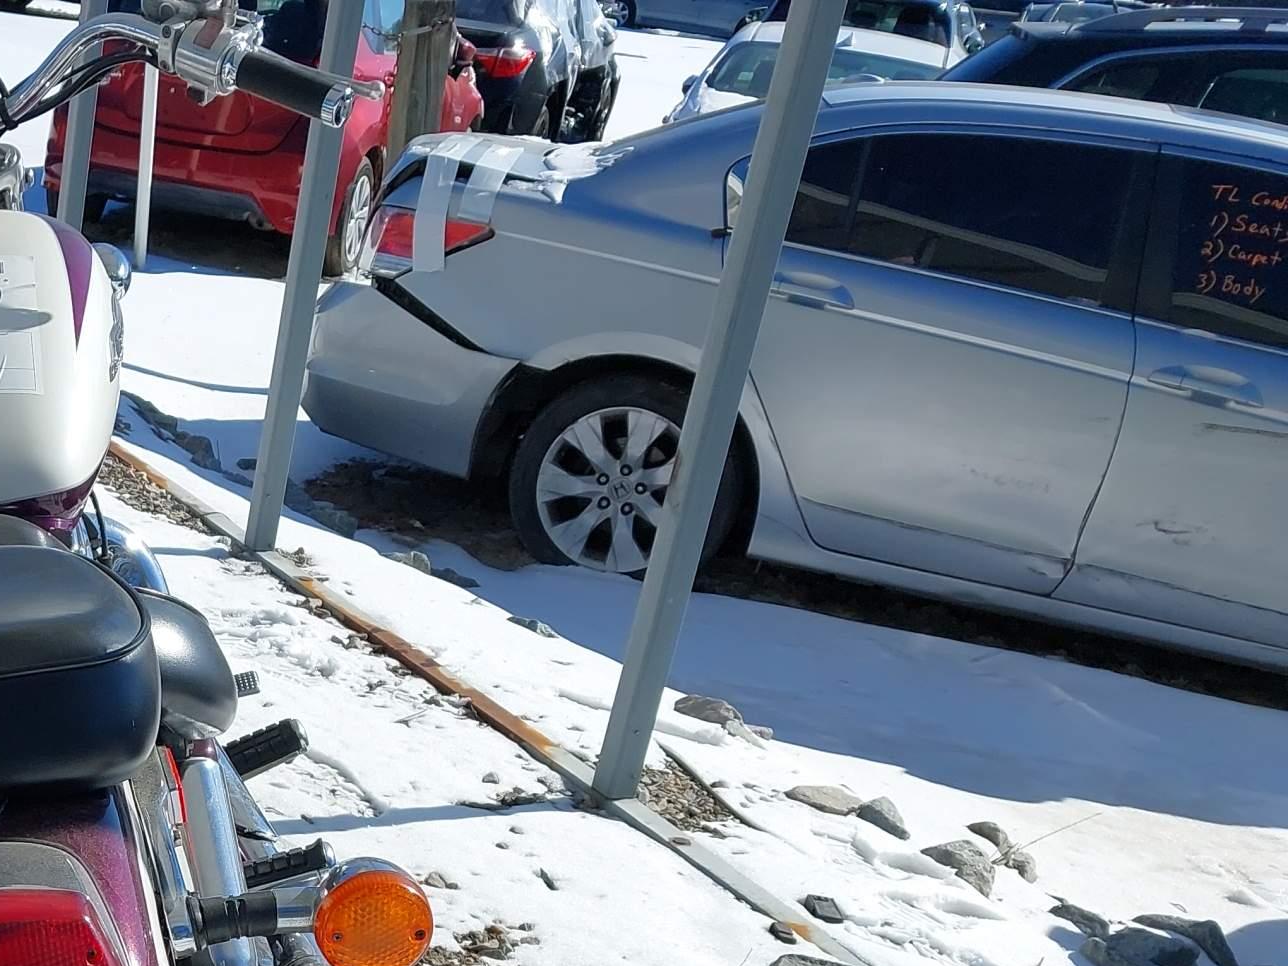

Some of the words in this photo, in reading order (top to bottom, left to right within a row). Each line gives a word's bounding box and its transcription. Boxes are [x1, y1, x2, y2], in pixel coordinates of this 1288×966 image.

[1212, 184, 1240, 202] TL
[1200, 239, 1224, 263] 2)
[1228, 244, 1282, 266] Carpet
[1196, 270, 1217, 293] 3)
[1222, 274, 1266, 304] Body
